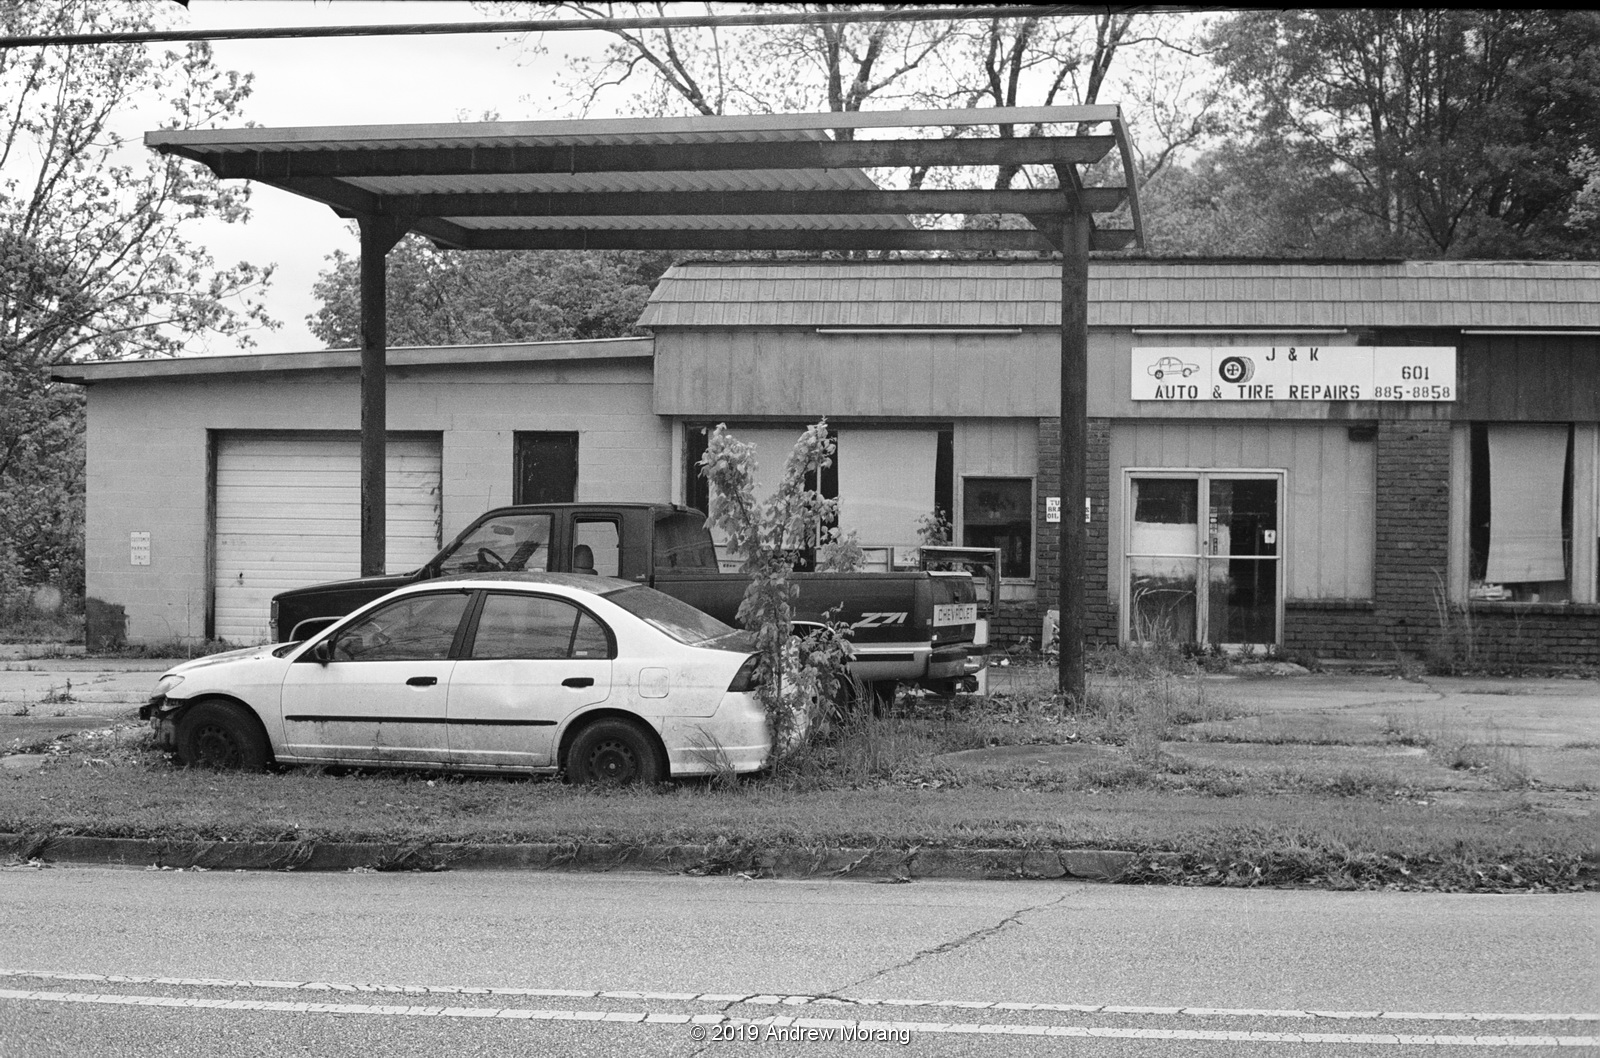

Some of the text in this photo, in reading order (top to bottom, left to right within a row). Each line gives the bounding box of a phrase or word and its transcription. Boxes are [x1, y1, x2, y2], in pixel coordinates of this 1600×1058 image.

[1265, 347, 1319, 362] J & K
[1402, 365, 1430, 381] 601
[1155, 385, 1360, 399] AUTO & TIRE REPAIRS
[1374, 385, 1451, 400] 885-8858
[851, 612, 908, 628] Z71
[938, 607, 974, 621] CHEVROLET
